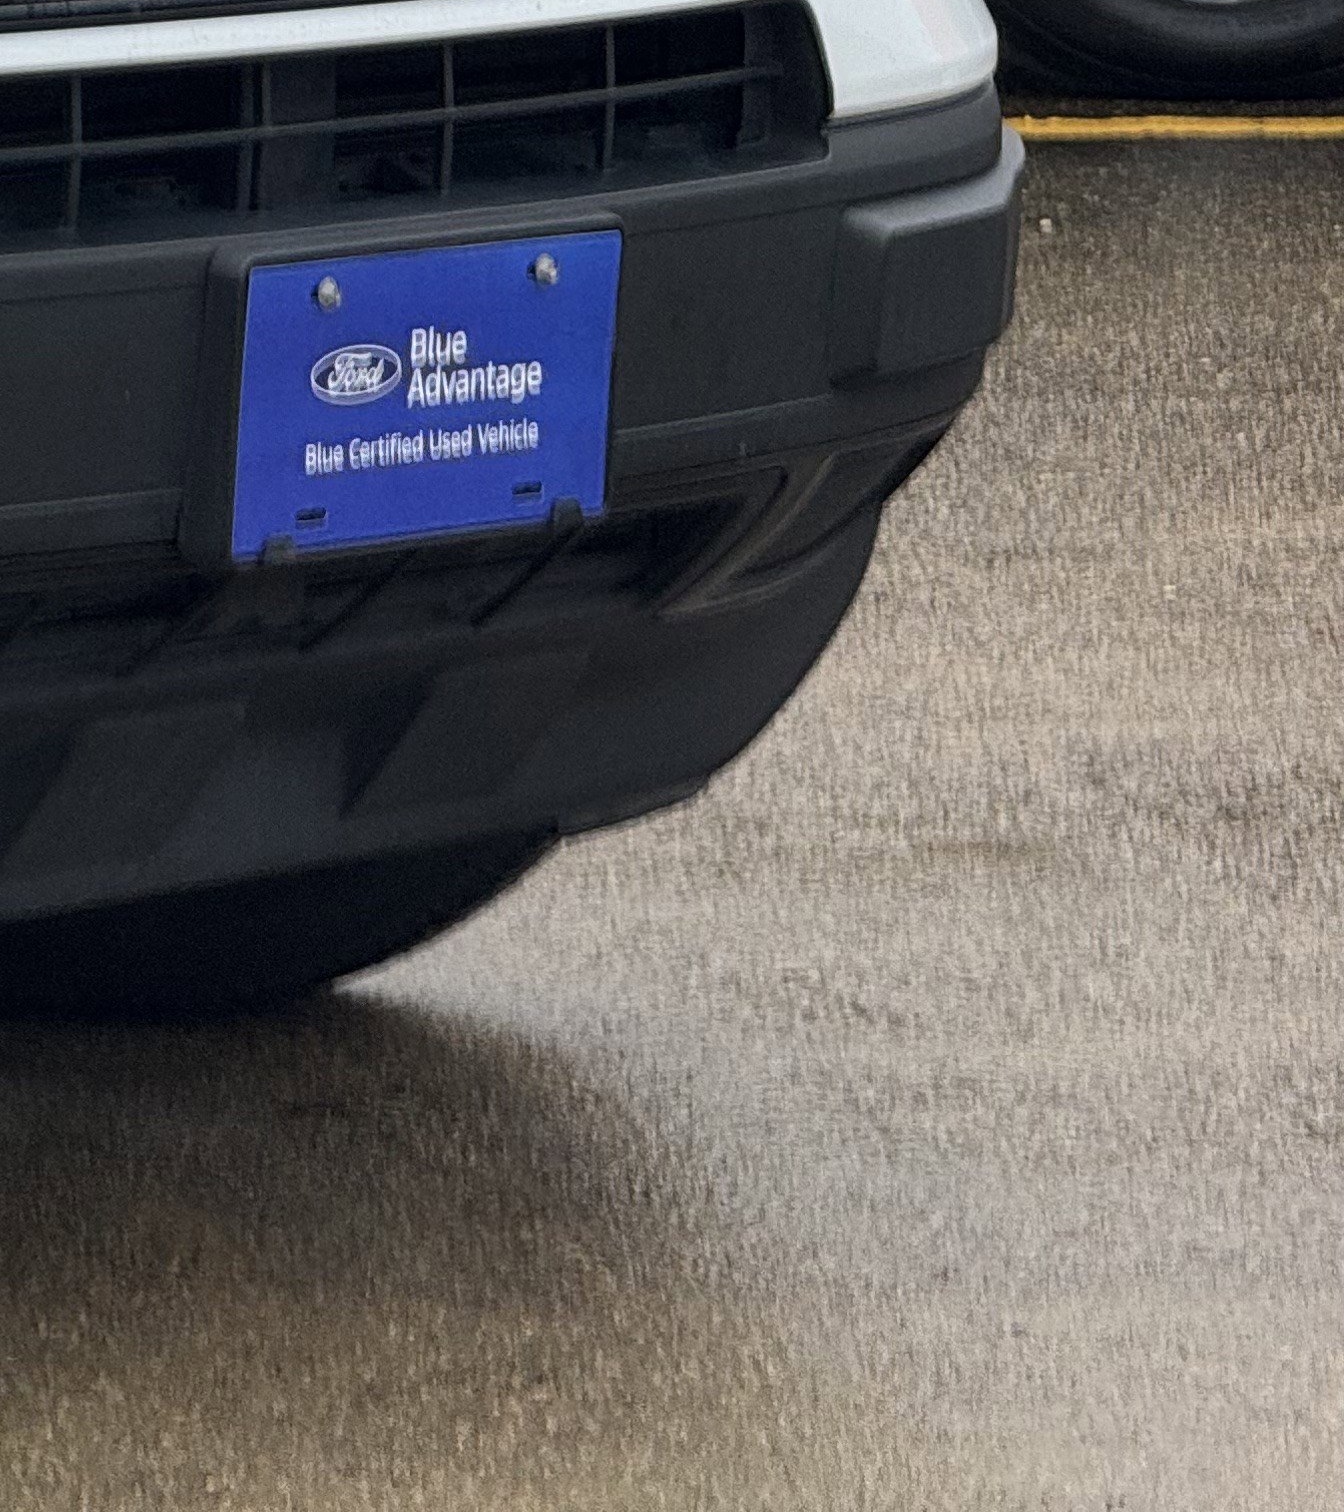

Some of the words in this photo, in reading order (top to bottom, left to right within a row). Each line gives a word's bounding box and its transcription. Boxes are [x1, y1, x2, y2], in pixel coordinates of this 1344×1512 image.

[410, 326, 467, 368] Blue
[326, 350, 387, 394] Ford
[407, 360, 543, 408] Advantage
[304, 442, 344, 476] Blue
[349, 430, 424, 470] Certified
[429, 424, 473, 460] Used
[478, 418, 540, 455] Vehicle
